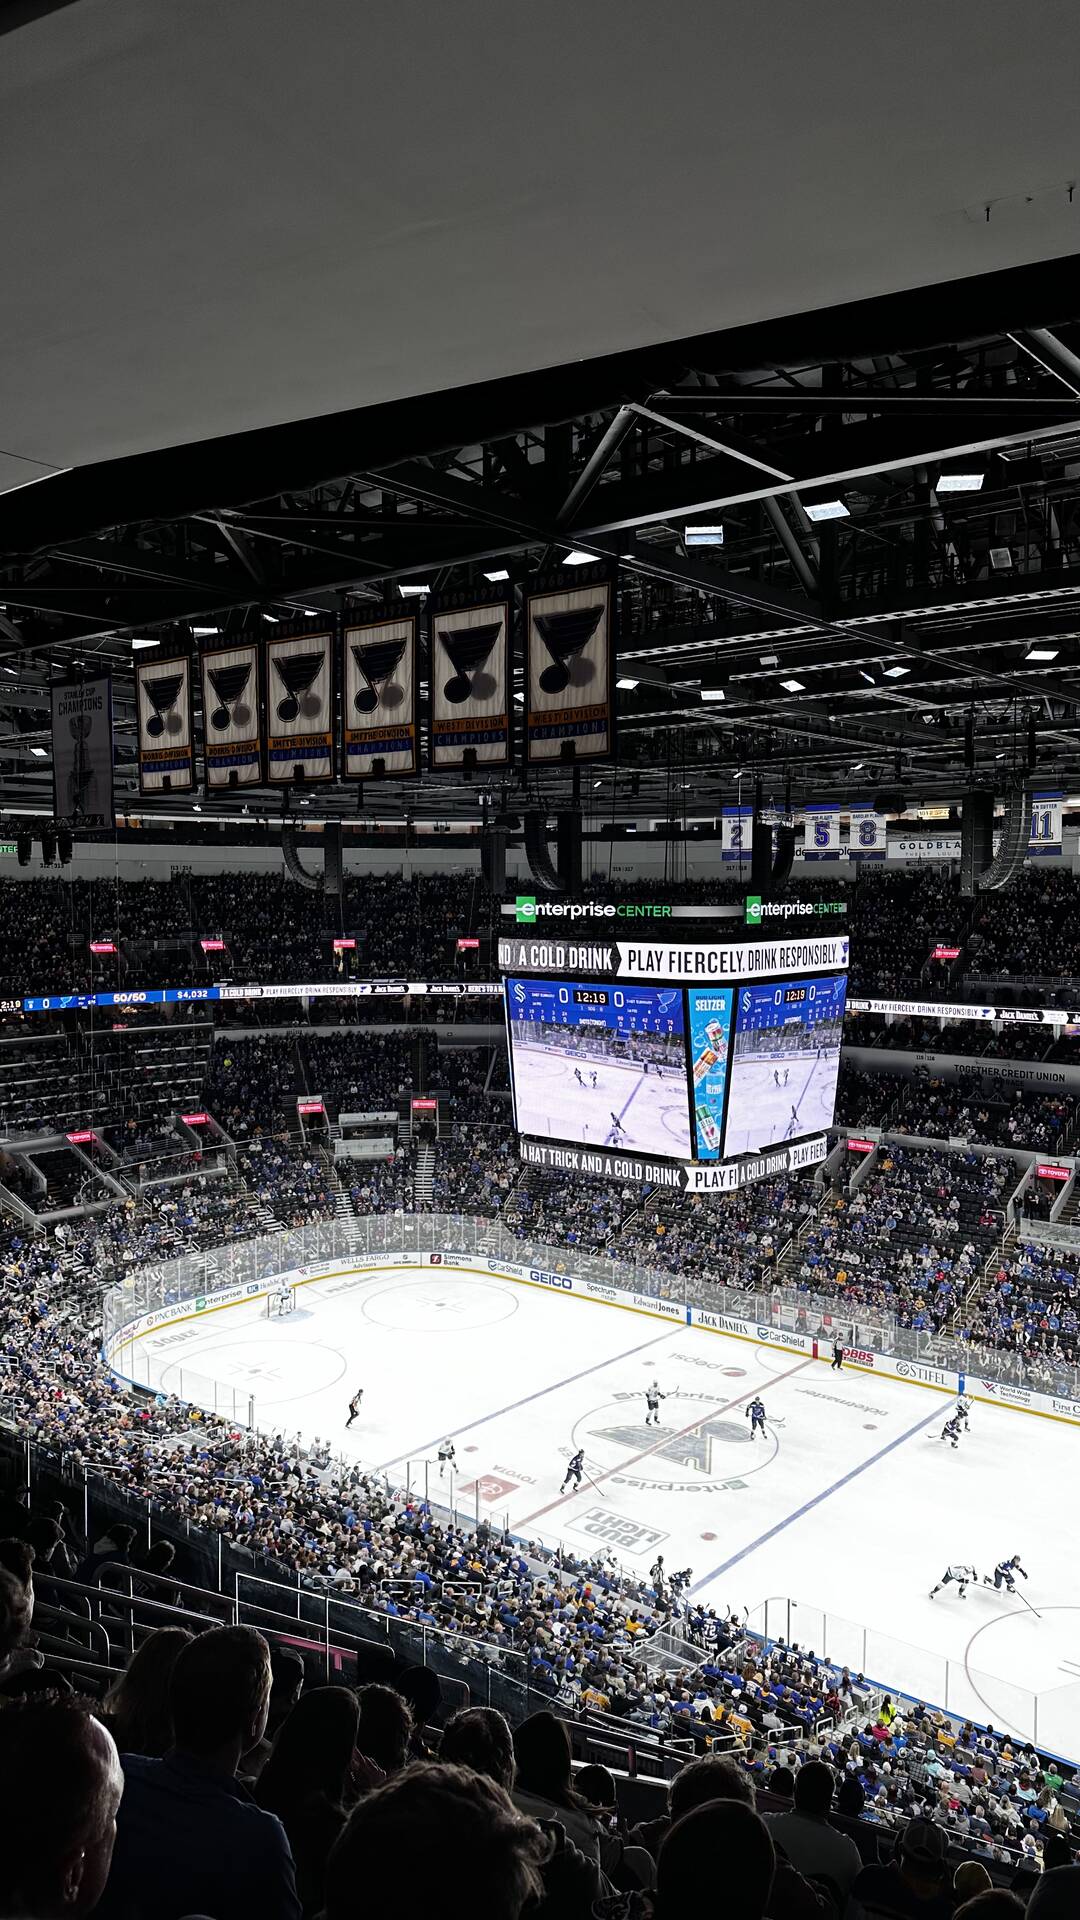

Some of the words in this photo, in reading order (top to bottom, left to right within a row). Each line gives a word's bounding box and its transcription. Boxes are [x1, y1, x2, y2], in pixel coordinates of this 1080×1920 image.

[534, 713, 559, 724] WEST
[563, 708, 606, 720] DIVISION
[437, 721, 461, 731] WEST
[465, 719, 504, 729] DIVISION
[530, 721, 607, 737] CHAMPIONS
[859, 820, 876, 846] 8
[1032, 811, 1053, 840] 11
[731, 824, 743, 848] 2
[814, 821, 829, 847] 5
[517, 900, 616, 920] enterprise
[617, 905, 672, 918] CENTER
[747, 900, 813, 919] enterprise
[813, 903, 843, 914] CENTER
[519, 945, 527, 966] A
[530, 945, 565, 968] COLD
[569, 947, 613, 970] DRINK
[628, 949, 664, 972] PLAY
[669, 951, 745, 974] FIERCELY.
[748, 948, 777, 972] DRINK
[780, 943, 838, 969] RESPONSIBLY.
[113, 993, 147, 1002] 50/50
[177, 990, 208, 999] $4,032
[559, 988, 569, 1003] 0
[576, 991, 606, 1004] 12:19
[614, 991, 624, 1007] 0
[774, 990, 782, 1005] 0
[786, 989, 805, 1002] 12:19
[808, 985, 816, 1001] 0
[42, 999, 50, 1008] 0
[695, 1000, 726, 1011] SELTZER
[873, 1003, 888, 1011] PLAY
[917, 1005, 936, 1014] DRINK
[565, 1049, 587, 1059] GEICO
[954, 1064, 999, 1076] TOGETHER
[1001, 1069, 1035, 1080] CREDIT
[1036, 1072, 1065, 1083] UNION
[793, 1146, 809, 1166] PLAY
[529, 1146, 547, 1164] HAT
[548, 1149, 579, 1170] TRICK
[581, 1154, 602, 1174] AND
[605, 1159, 612, 1175] A
[614, 1159, 642, 1180] COLD
[645, 1165, 681, 1187] DRINK
[740, 1167, 747, 1182] A
[747, 1161, 765, 1180] COLD
[766, 1152, 788, 1174] DRINK
[1048, 1169, 1069, 1178] TOYOTA
[695, 1171, 726, 1188] PLAY
[340, 1256, 364, 1266] WELLS
[365, 1253, 390, 1263] FARGO
[443, 1253, 473, 1262] Simmons
[497, 1262, 523, 1276] CarShield
[530, 1270, 572, 1290] GEICO
[633, 1295, 658, 1310] Edward
[658, 1300, 680, 1315] Jones
[769, 1332, 805, 1347] CarShield
[910, 1365, 948, 1385] STIFEL
[999, 1385, 1016, 1394] World
[1052, 1399, 1071, 1412] First
[492, 1464, 537, 1486] TOYOTA
[586, 1509, 663, 1543] LIGHT
[584, 1523, 641, 1547] BUD
[703, 1624, 716, 1635] 72
